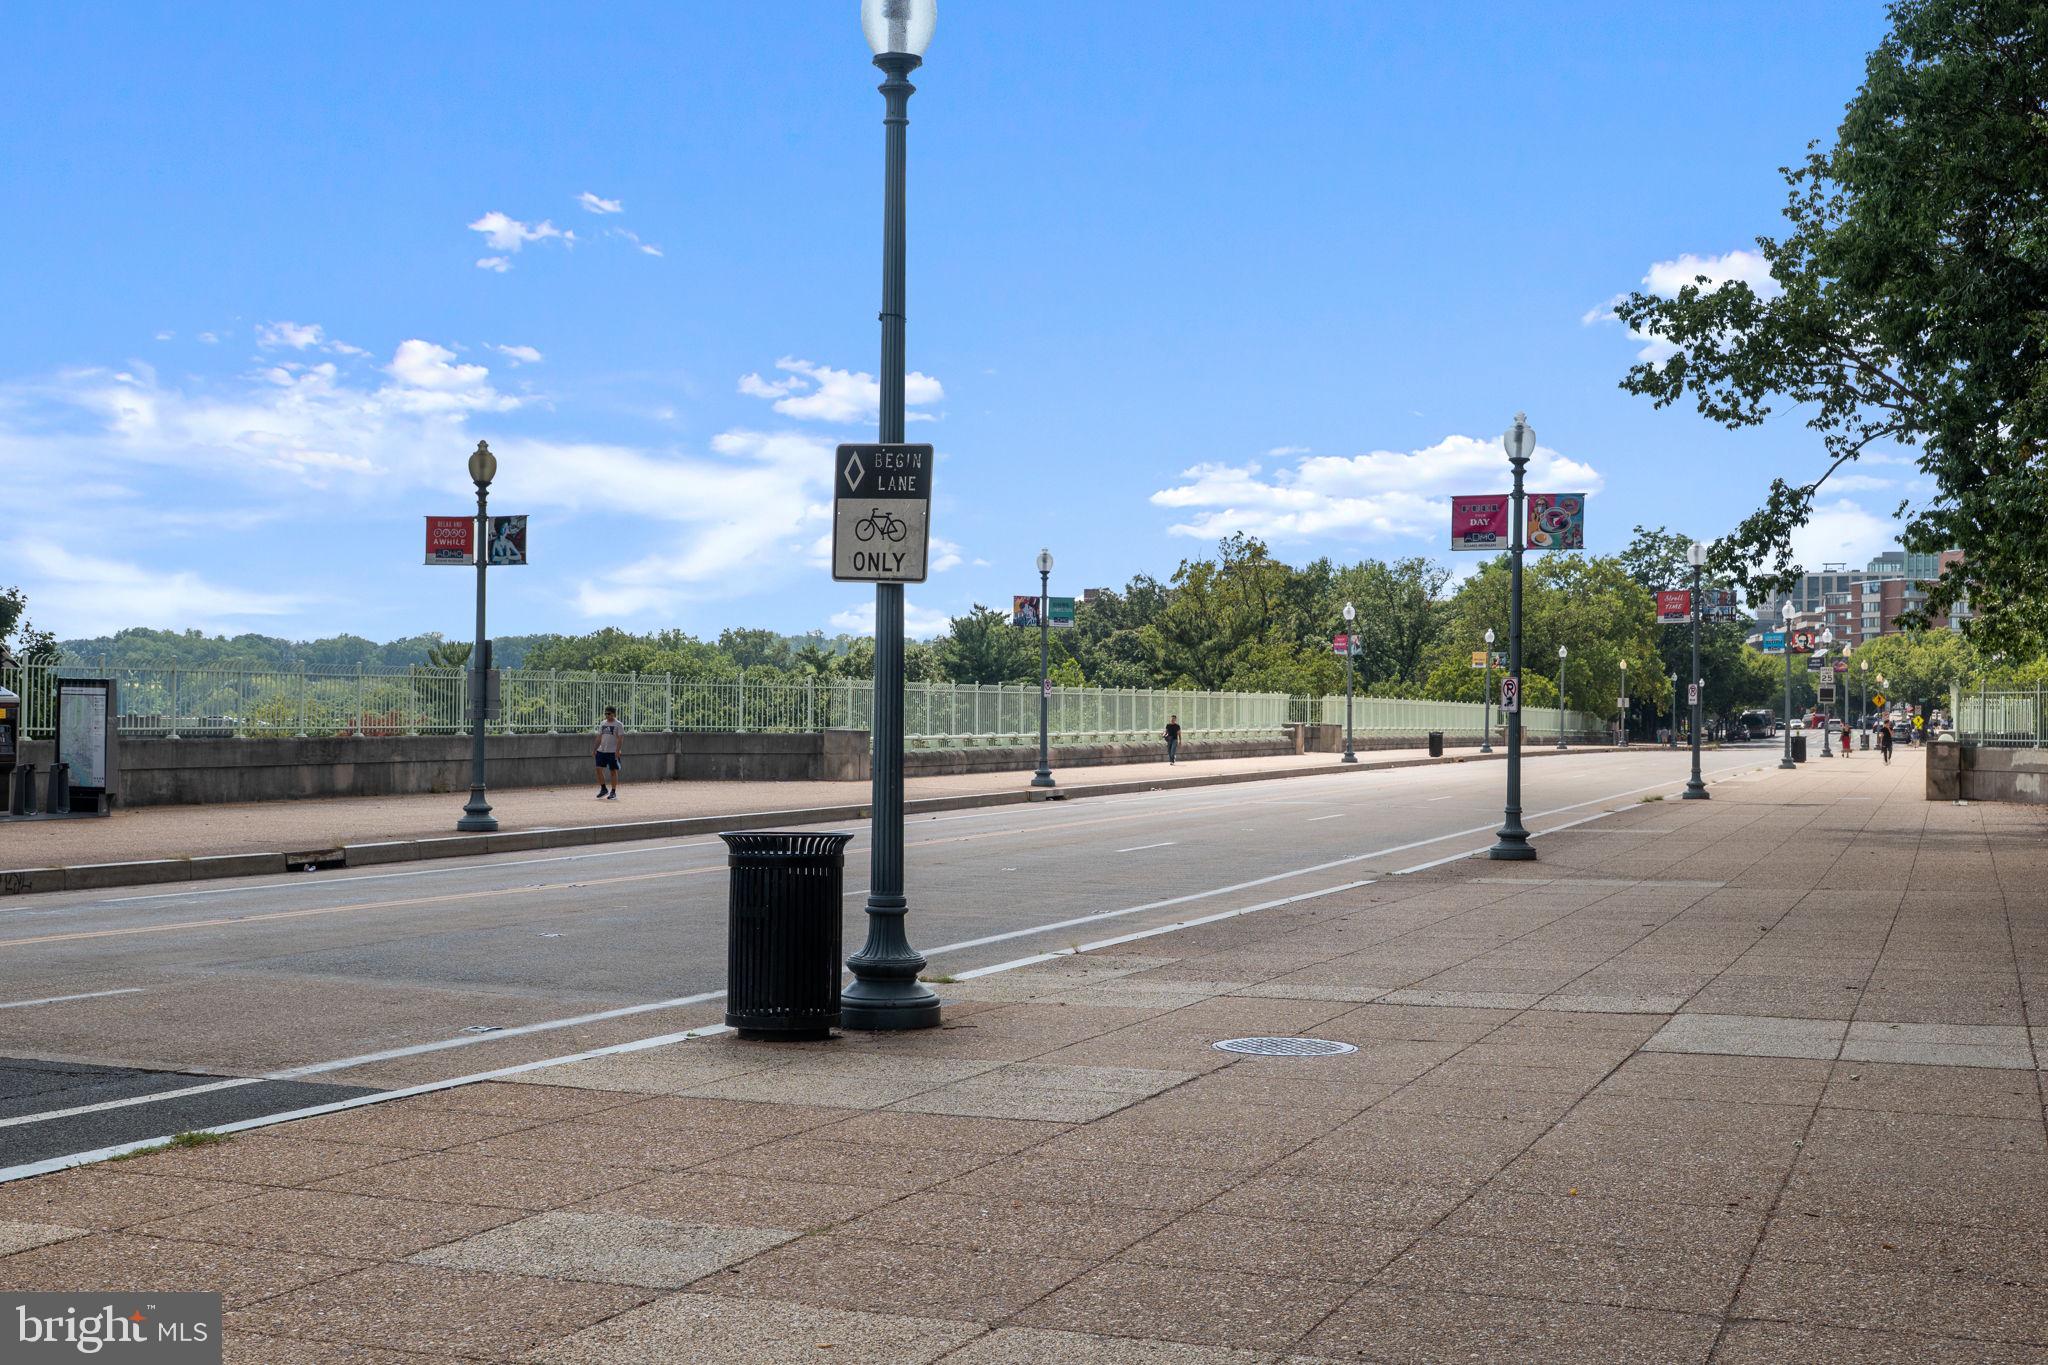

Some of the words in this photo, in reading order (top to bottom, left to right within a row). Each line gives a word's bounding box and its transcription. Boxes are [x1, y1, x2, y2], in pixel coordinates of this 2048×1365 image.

[875, 453, 921, 468] BEGIN
[878, 476, 916, 491] LANE
[1470, 518, 1490, 526] DAY
[433, 538, 466, 546] AWHILE
[853, 551, 906, 572] ONLY
[1821, 674, 1833, 682] 25
